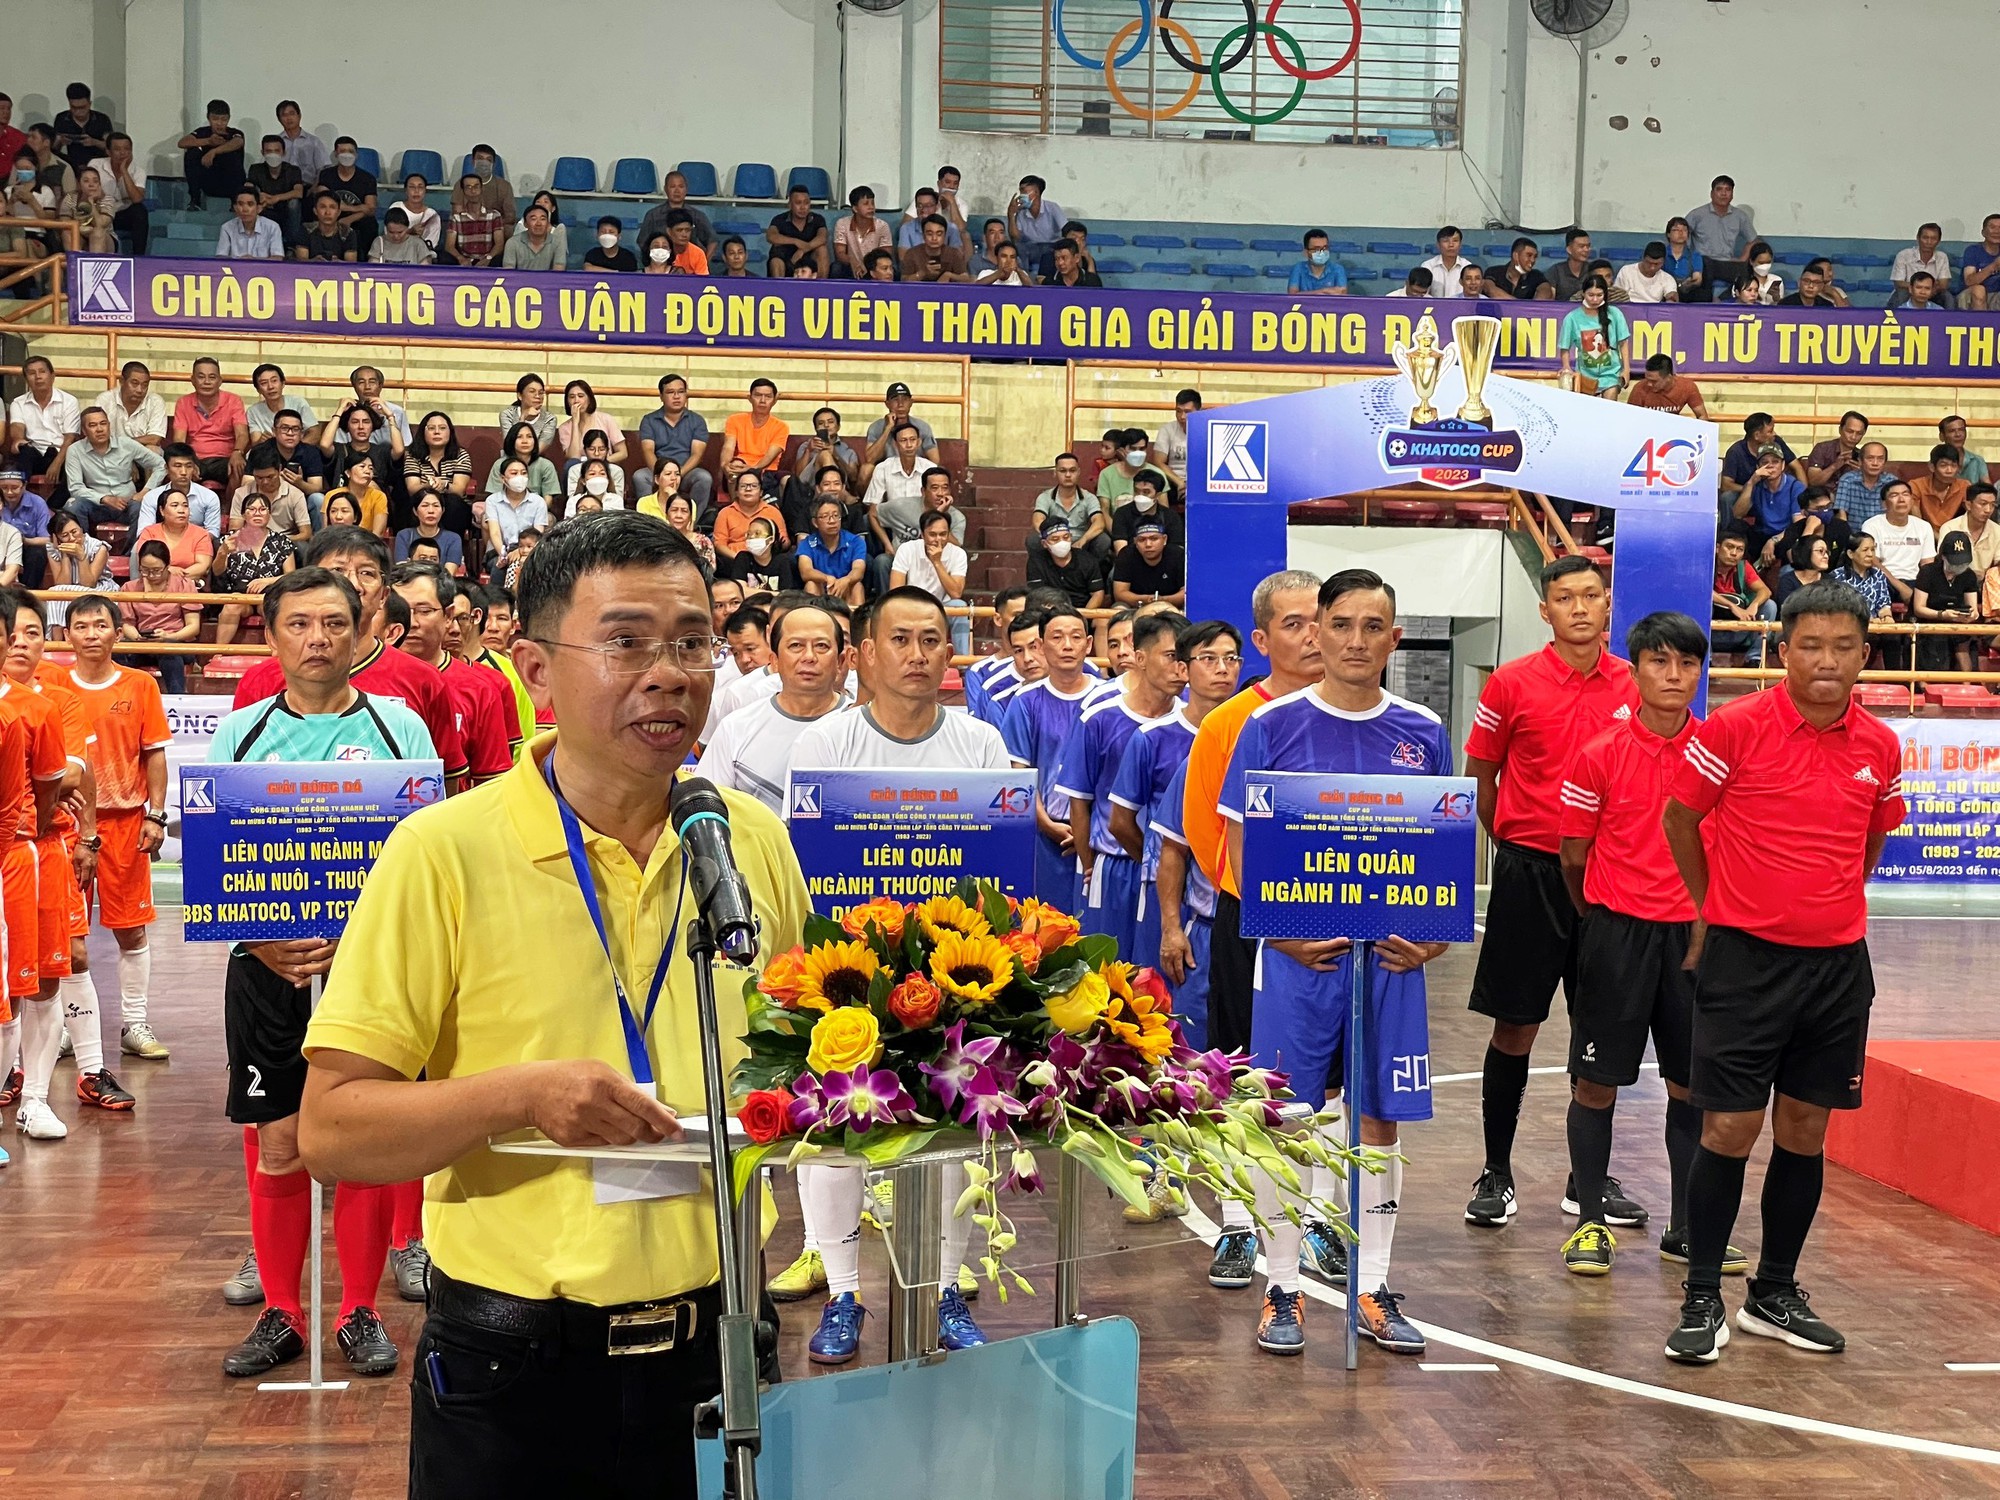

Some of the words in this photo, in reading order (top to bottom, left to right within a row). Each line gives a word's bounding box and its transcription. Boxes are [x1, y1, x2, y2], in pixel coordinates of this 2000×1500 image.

[80, 313, 133, 321] KHATOCO
[151, 267, 276, 319] CHÀO
[294, 272, 435, 325] MỪNG
[454, 278, 542, 329] CÁC
[559, 282, 646, 341] VẬN
[663, 285, 786, 344] ĐỘNG
[802, 290, 900, 342] VIÊN
[917, 301, 1042, 346] THAM
[1060, 305, 1131, 348] GIA
[1148, 297, 1234, 351] GIẢI
[1252, 304, 1366, 354] BÓNG
[1500, 317, 1557, 358] INI
[1703, 313, 1762, 363] NỮ
[1775, 310, 1929, 366] TRUYỀN
[1945, 326, 2000, 366] TH
[1410, 443, 1481, 457] KHATOCO
[1482, 444, 1515, 457] CUP
[1622, 437, 1704, 487] 40
[1435, 469, 1469, 480] 2023
[1901, 737, 1932, 772] ẢI
[1917, 796, 1956, 813] TỔNG
[266, 816, 277, 825] 40
[868, 823, 878, 831] 40
[1917, 822, 1961, 836] THÀNH
[1965, 822, 1991, 839] LẬP
[223, 839, 258, 863] LIÊN
[263, 838, 305, 864] QUÂN
[310, 837, 363, 861] NGÀNH
[863, 844, 904, 866] LIÊN
[911, 844, 963, 868] QUÂN
[1304, 847, 1350, 873] LIÊN
[1358, 849, 1415, 876] QUÂN
[1922, 846, 1960, 858] (1983
[223, 869, 266, 892] CHĂN
[271, 868, 309, 891] NUÔI
[1877, 864, 1906, 877] ngày
[1909, 865, 1963, 875] 05/8/2023
[1966, 864, 1988, 875] đến
[809, 872, 874, 895] NGÀNH
[1261, 877, 1334, 903] NGÀNH
[1341, 883, 1363, 904] IN
[1386, 884, 1429, 906] BAO
[1436, 881, 1457, 906] BÌ
[183, 903, 213, 923] BĐS
[217, 902, 296, 924] KHATOCO,
[300, 901, 321, 920] VP
[64, 1009, 93, 1018] egan
[247, 1064, 266, 1097] 2
[1393, 1053, 1430, 1092] 20
